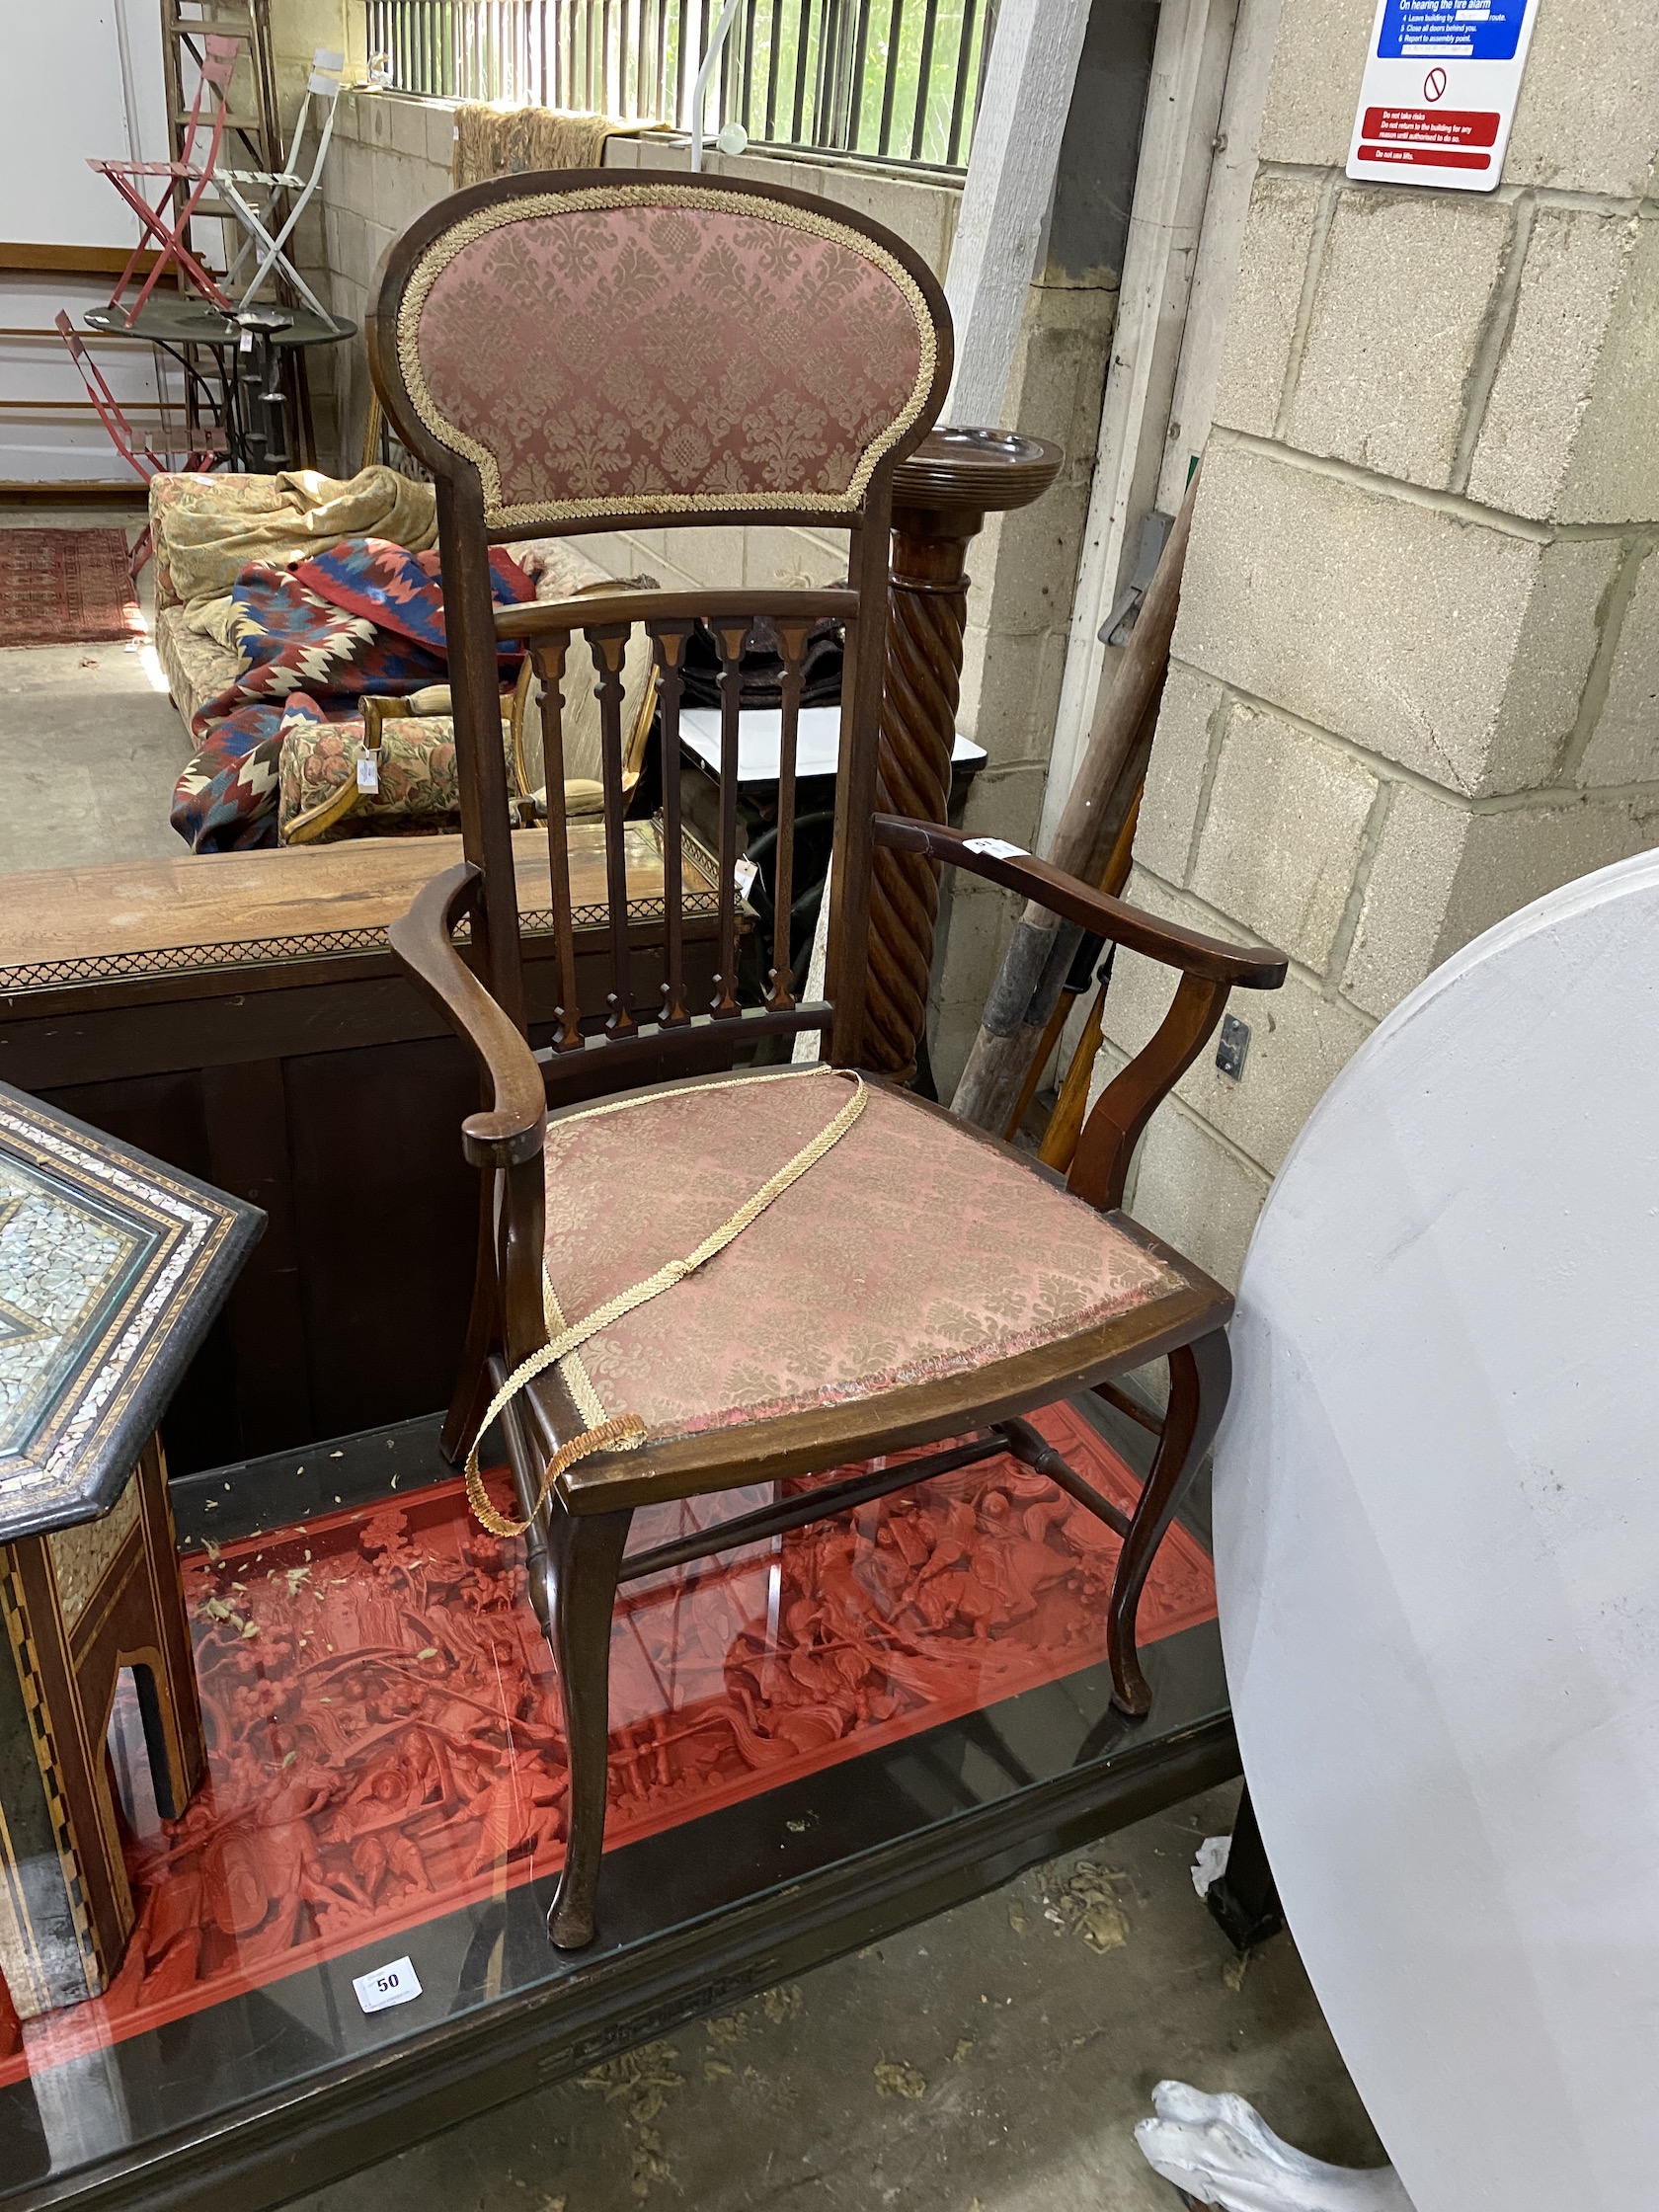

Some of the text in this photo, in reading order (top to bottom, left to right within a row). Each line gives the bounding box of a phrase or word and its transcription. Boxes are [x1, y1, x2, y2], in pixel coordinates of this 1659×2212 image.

[1399, 0, 1491, 11] On hearing the fire alarm
[1404, 35, 1422, 43] Report
[1429, 35, 1455, 43] assembly
[1431, 122, 1452, 132] building
[376, 1974, 399, 1992] 50
